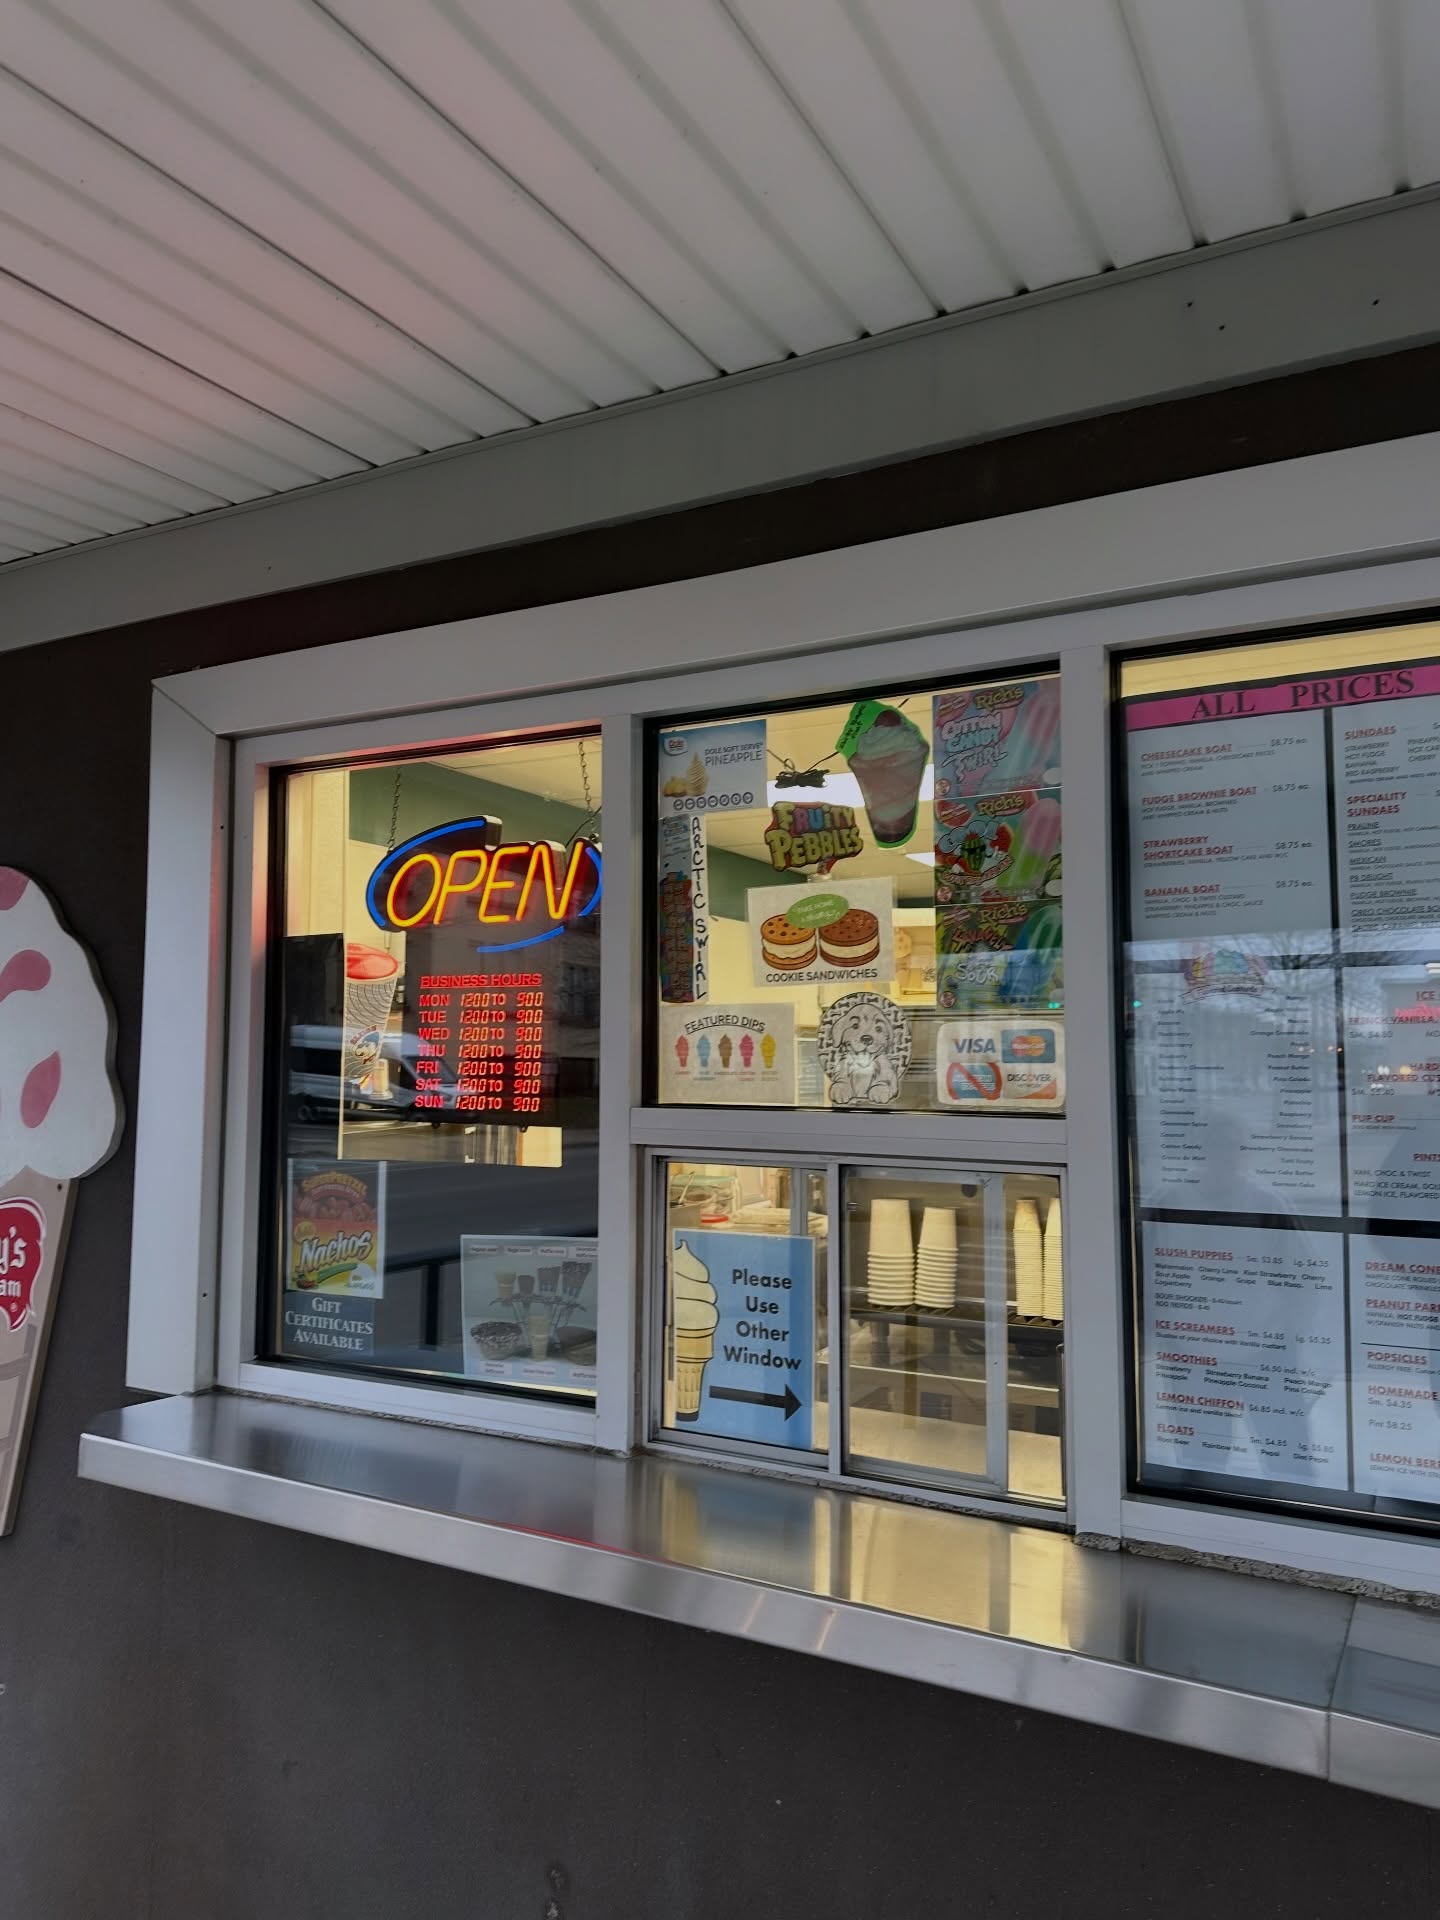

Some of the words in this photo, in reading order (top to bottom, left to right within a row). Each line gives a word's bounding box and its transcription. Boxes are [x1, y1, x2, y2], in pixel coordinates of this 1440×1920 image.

[1192, 692, 1256, 719] ALL
[1291, 670, 1415, 708] PRICES
[1344, 725, 1397, 740] SUNDAES
[723, 744, 739, 753] SOFT
[1141, 746, 1202, 762] CHEESECAKE
[1205, 743, 1232, 754] BOAT
[705, 750, 763, 767] PINEAPPLE
[1142, 794, 1175, 806] FUDGE
[1178, 789, 1227, 801] BROWNIE
[1229, 785, 1257, 796] BOAT
[976, 795, 1025, 817] Rich's
[1347, 804, 1401, 817] SUNDAES
[765, 828, 863, 872] PEBBLES
[1143, 836, 1208, 849] STRAWBERRY
[1144, 847, 1203, 860] SHORTCAKE
[1205, 845, 1233, 855] BOAT
[692, 816, 706, 909] ARCTIC
[387, 841, 584, 927] OPEN
[1144, 886, 1190, 897] BANANA
[1193, 884, 1221, 894] BOAT
[979, 903, 1028, 924] Rich's
[694, 918, 709, 1000] SWIRL
[420, 974, 488, 988] BUSINESS
[491, 973, 542, 987] HOURS
[766, 971, 802, 983] COOKIE
[806, 968, 878, 982] SANDWICHES
[420, 994, 451, 1007] MON
[491, 994, 506, 1006] TO
[1416, 990, 1435, 1001] ICE
[419, 1010, 447, 1023] TUE
[491, 1011, 506, 1023] TO
[684, 1014, 739, 1033] FEATURED
[741, 1016, 766, 1033] DIPS
[418, 1027, 451, 1040] WED
[490, 1028, 505, 1040] TO
[418, 1044, 445, 1057] THU
[490, 1045, 504, 1057] TO
[953, 1039, 996, 1054] VISA
[416, 1061, 439, 1074] FRI
[489, 1062, 504, 1074] TO
[415, 1078, 442, 1091] SAT
[488, 1080, 503, 1092] TO
[1007, 1073, 1051, 1082] DISCOVER
[414, 1095, 444, 1108] SUN
[487, 1097, 502, 1110] TO
[1374, 1114, 1395, 1123] CUP
[299, 1229, 374, 1273] Nachos
[1155, 1248, 1188, 1258] SLUSH
[1191, 1250, 1234, 1261] PUPPIES
[1365, 1261, 1406, 1273] DREAM
[732, 1268, 793, 1289] Please
[1200, 1274, 1225, 1283] Orange
[1315, 1283, 1333, 1291] Lime
[311, 1297, 341, 1314] GIFT
[746, 1296, 780, 1314] Use
[1366, 1299, 1411, 1311] PEANUT
[285, 1311, 373, 1335] CERTIFICATES
[1155, 1319, 1171, 1330] ICE
[1173, 1321, 1235, 1336] SCREAMERS
[736, 1321, 789, 1341] Other
[293, 1329, 364, 1351] AVAILABLE
[723, 1345, 801, 1370] Window
[1156, 1351, 1218, 1367] SMOOTHIES
[1367, 1351, 1427, 1366] POPSICLES
[1205, 1368, 1242, 1379] Strawberry
[1203, 1376, 1237, 1387] Pineapple
[1238, 1380, 1267, 1390] Coconut
[1157, 1391, 1194, 1405] LEMON
[1197, 1397, 1244, 1410] CHIFFON
[1368, 1385, 1438, 1401] HOMEMADE
[1157, 1423, 1195, 1436] FLOATS
[1370, 1452, 1411, 1466] LEMON
